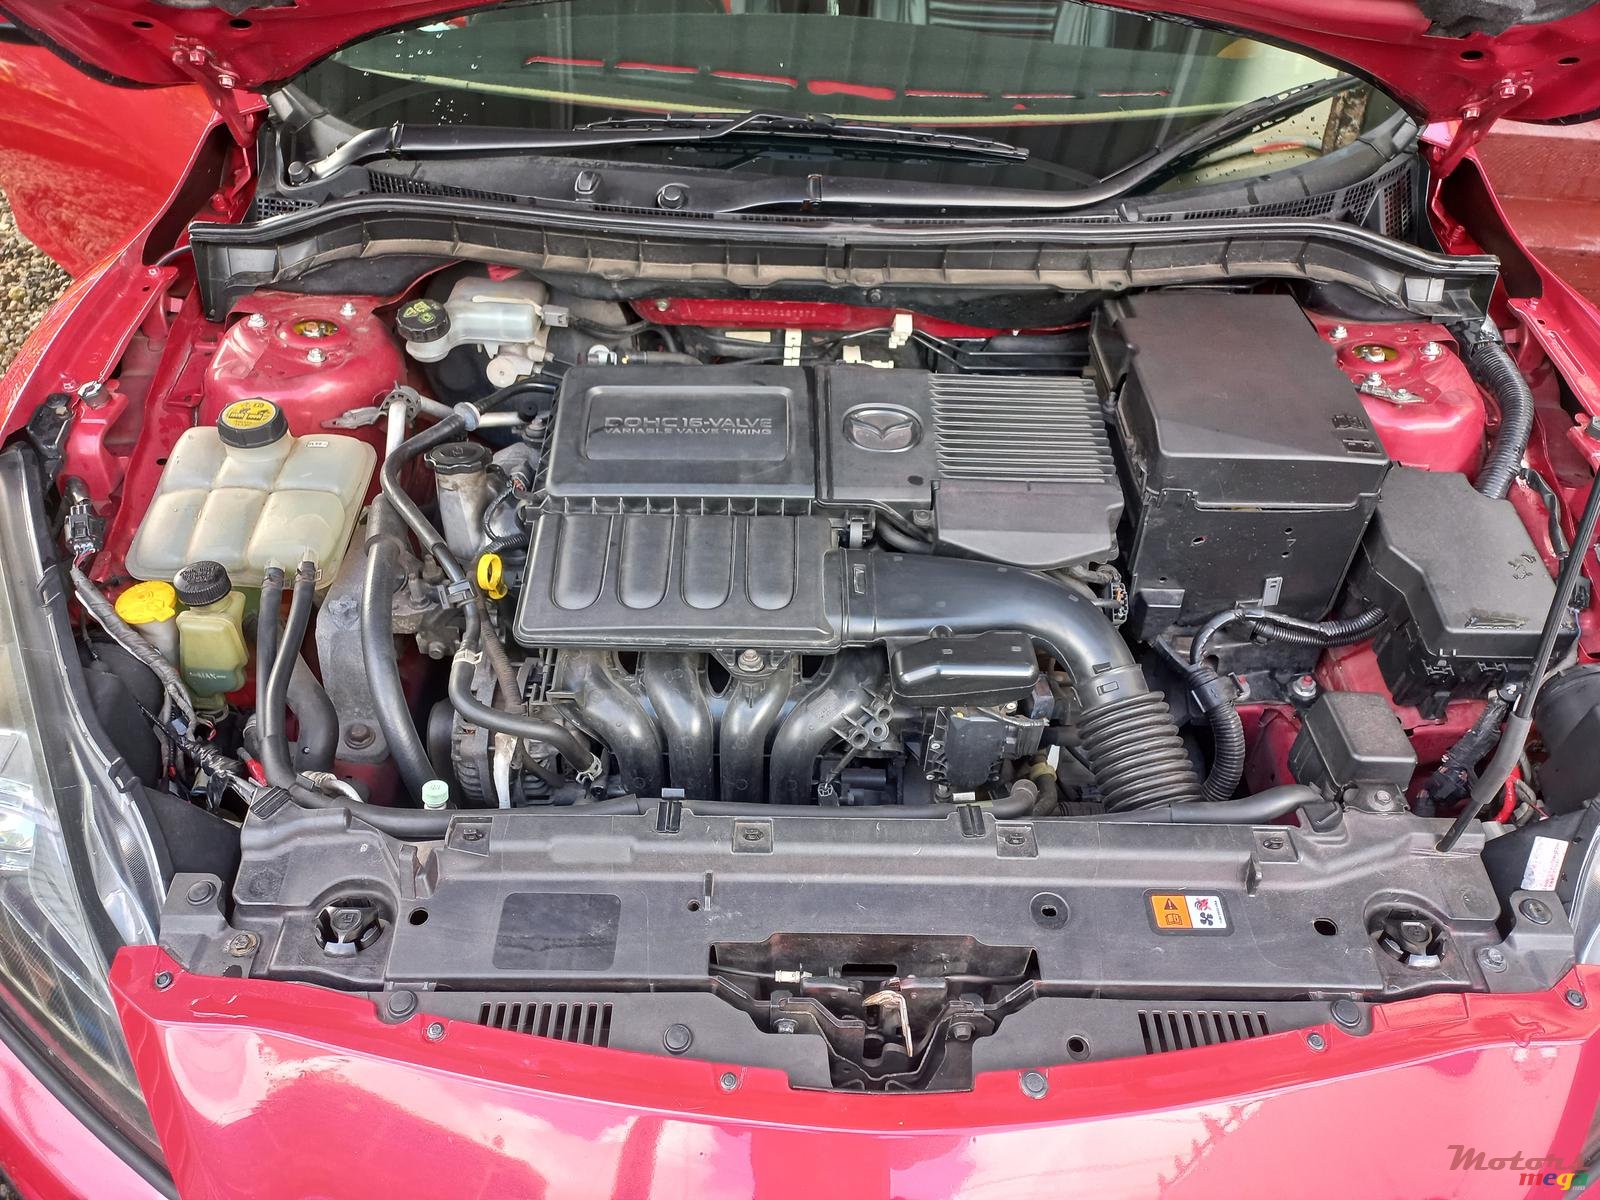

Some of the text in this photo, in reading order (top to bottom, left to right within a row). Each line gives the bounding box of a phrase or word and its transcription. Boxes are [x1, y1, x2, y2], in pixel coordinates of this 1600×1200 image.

[604, 416, 773, 429] DOHC 16-VALVE
[604, 427, 772, 436] VARIABLE VALVE TIMING
